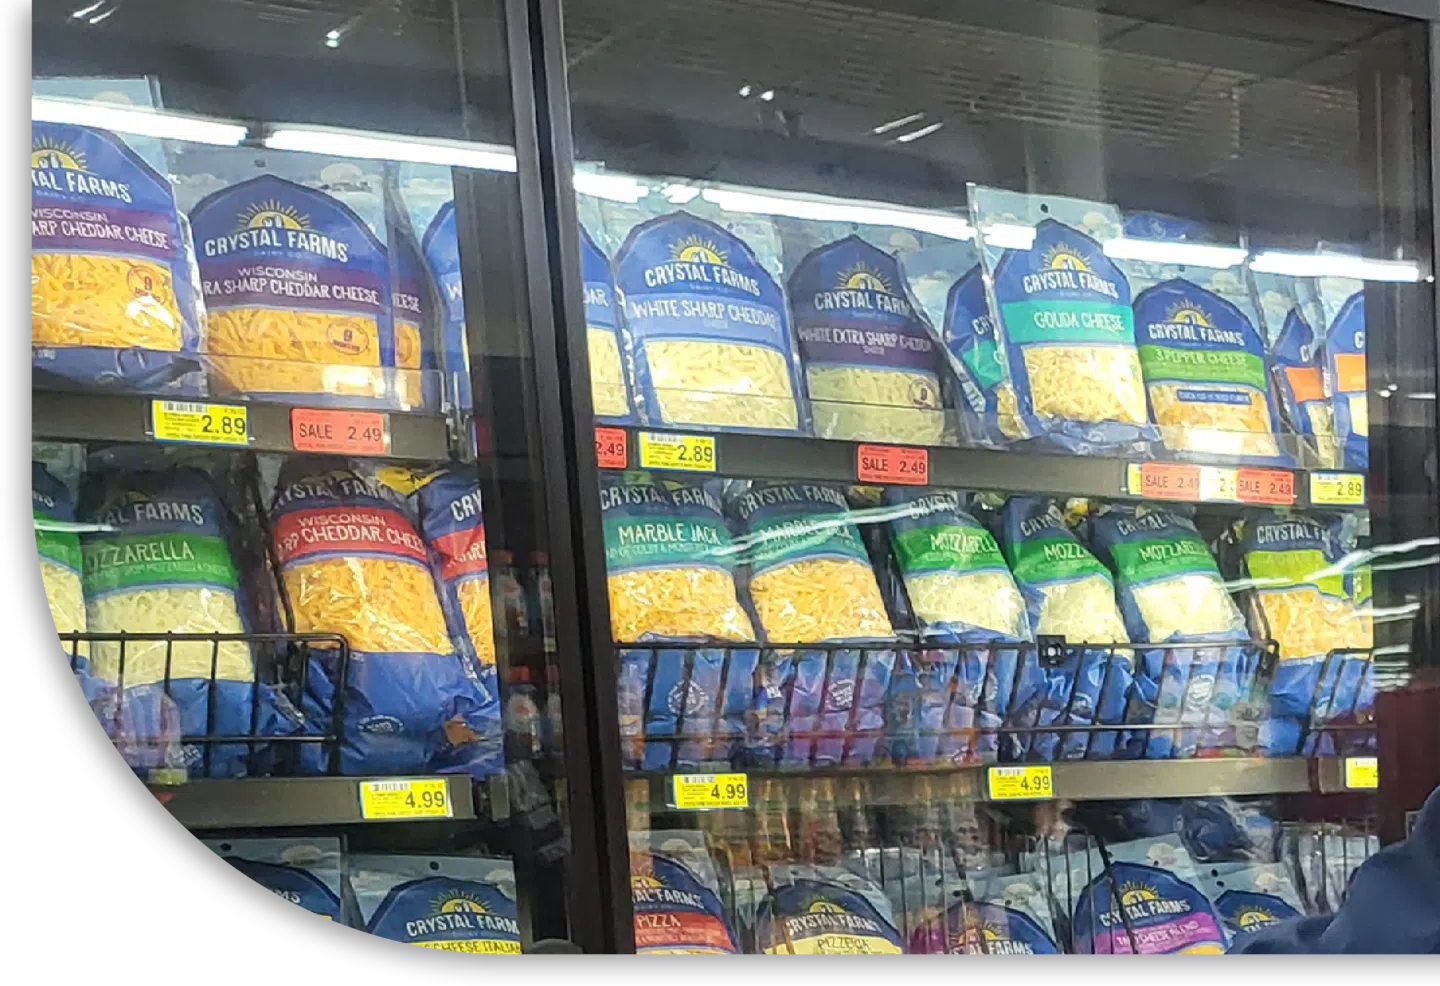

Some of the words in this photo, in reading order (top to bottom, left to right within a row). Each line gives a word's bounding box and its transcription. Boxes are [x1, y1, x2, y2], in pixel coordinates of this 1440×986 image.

[66, 171, 132, 203] FARMS
[61, 221, 124, 240] CHEDDAR
[124, 226, 169, 249] CHEESE
[204, 231, 282, 257] CRYSTAL
[287, 231, 349, 263] FARMS
[238, 266, 318, 283] WISCONSIN
[645, 262, 712, 287] CRYSTAL
[713, 262, 761, 296] FARMS
[225, 277, 267, 295] SHARP
[270, 280, 331, 299] CHEDDAR
[332, 285, 380, 305] CHEESE
[1023, 271, 1079, 294] CRYSTAL
[1079, 271, 1120, 299] FARMS
[632, 299, 680, 319] WHITE
[682, 300, 727, 320] SHARP
[814, 291, 874, 311] CRYSTAL
[1033, 312, 1080, 329] GOUDA
[1081, 314, 1126, 333] CHEESE
[799, 326, 833, 344] WHITE
[833, 327, 866, 346] EXTRA
[865, 331, 898, 348] SHARP
[1148, 324, 1199, 342] CRYSTAL
[1200, 325, 1245, 347] FARMS
[1164, 349, 1204, 366] PEPPER
[1206, 350, 1247, 367] CHEESE
[202, 414, 246, 436] 2.89
[299, 422, 333, 440] SALE
[347, 426, 382, 442] 2.49
[677, 444, 713, 463] 2.89
[861, 456, 890, 472] SALE
[899, 460, 926, 475] 2.49
[1145, 475, 1169, 489] SALE
[1239, 480, 1260, 494] SALE
[1269, 482, 1292, 495] 2.49
[1337, 481, 1362, 497] 2.89
[739, 485, 802, 520] CRYSTAL
[134, 502, 204, 526] FARMS
[298, 512, 386, 527] WISCONSIN
[302, 525, 384, 544] CHEDDAR
[618, 523, 685, 546] MARBLE
[690, 523, 722, 546] JACK
[1256, 524, 1312, 544] CRYSTAL
[710, 784, 746, 800] 4.99
[1020, 775, 1050, 791] 4.99
[405, 789, 445, 808] 4.99
[657, 888, 705, 910] FARMS
[1149, 898, 1191, 917] FARMS
[406, 912, 475, 937] CRYSTAL
[638, 914, 682, 928] PIZZA
